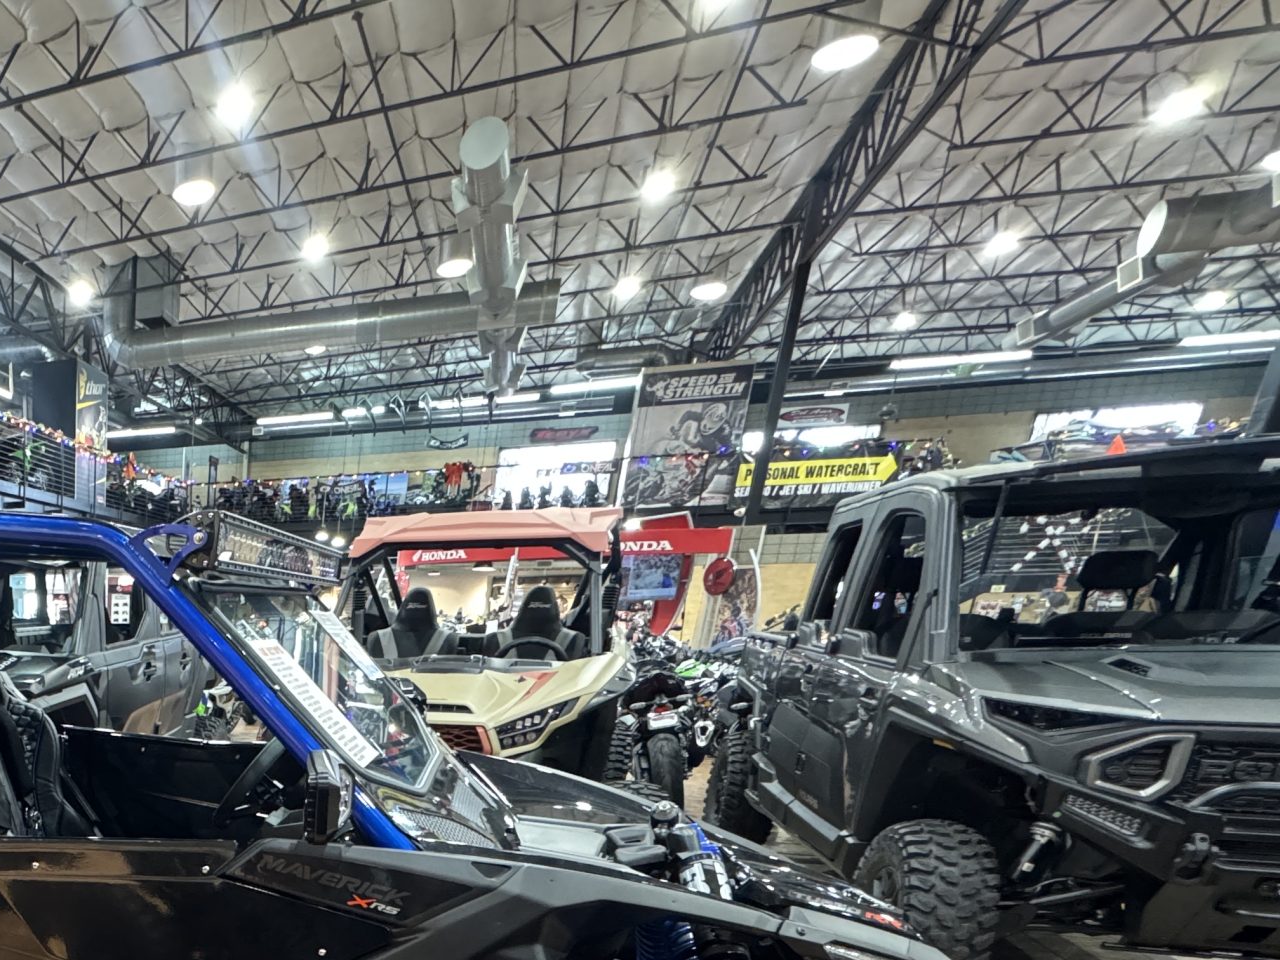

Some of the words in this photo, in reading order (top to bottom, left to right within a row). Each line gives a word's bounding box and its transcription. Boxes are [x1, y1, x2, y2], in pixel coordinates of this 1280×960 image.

[86, 380, 106, 395] thor
[669, 374, 718, 387] SPEED
[665, 381, 747, 399] STRENGTH
[743, 465, 801, 482] PSONAL
[805, 461, 882, 478] WATERCRAFT
[779, 484, 797, 496] JET
[797, 483, 813, 496] SKI
[421, 549, 468, 562] HONDA
[257, 853, 412, 905] MAVERICK
[346, 893, 401, 916] XRS
